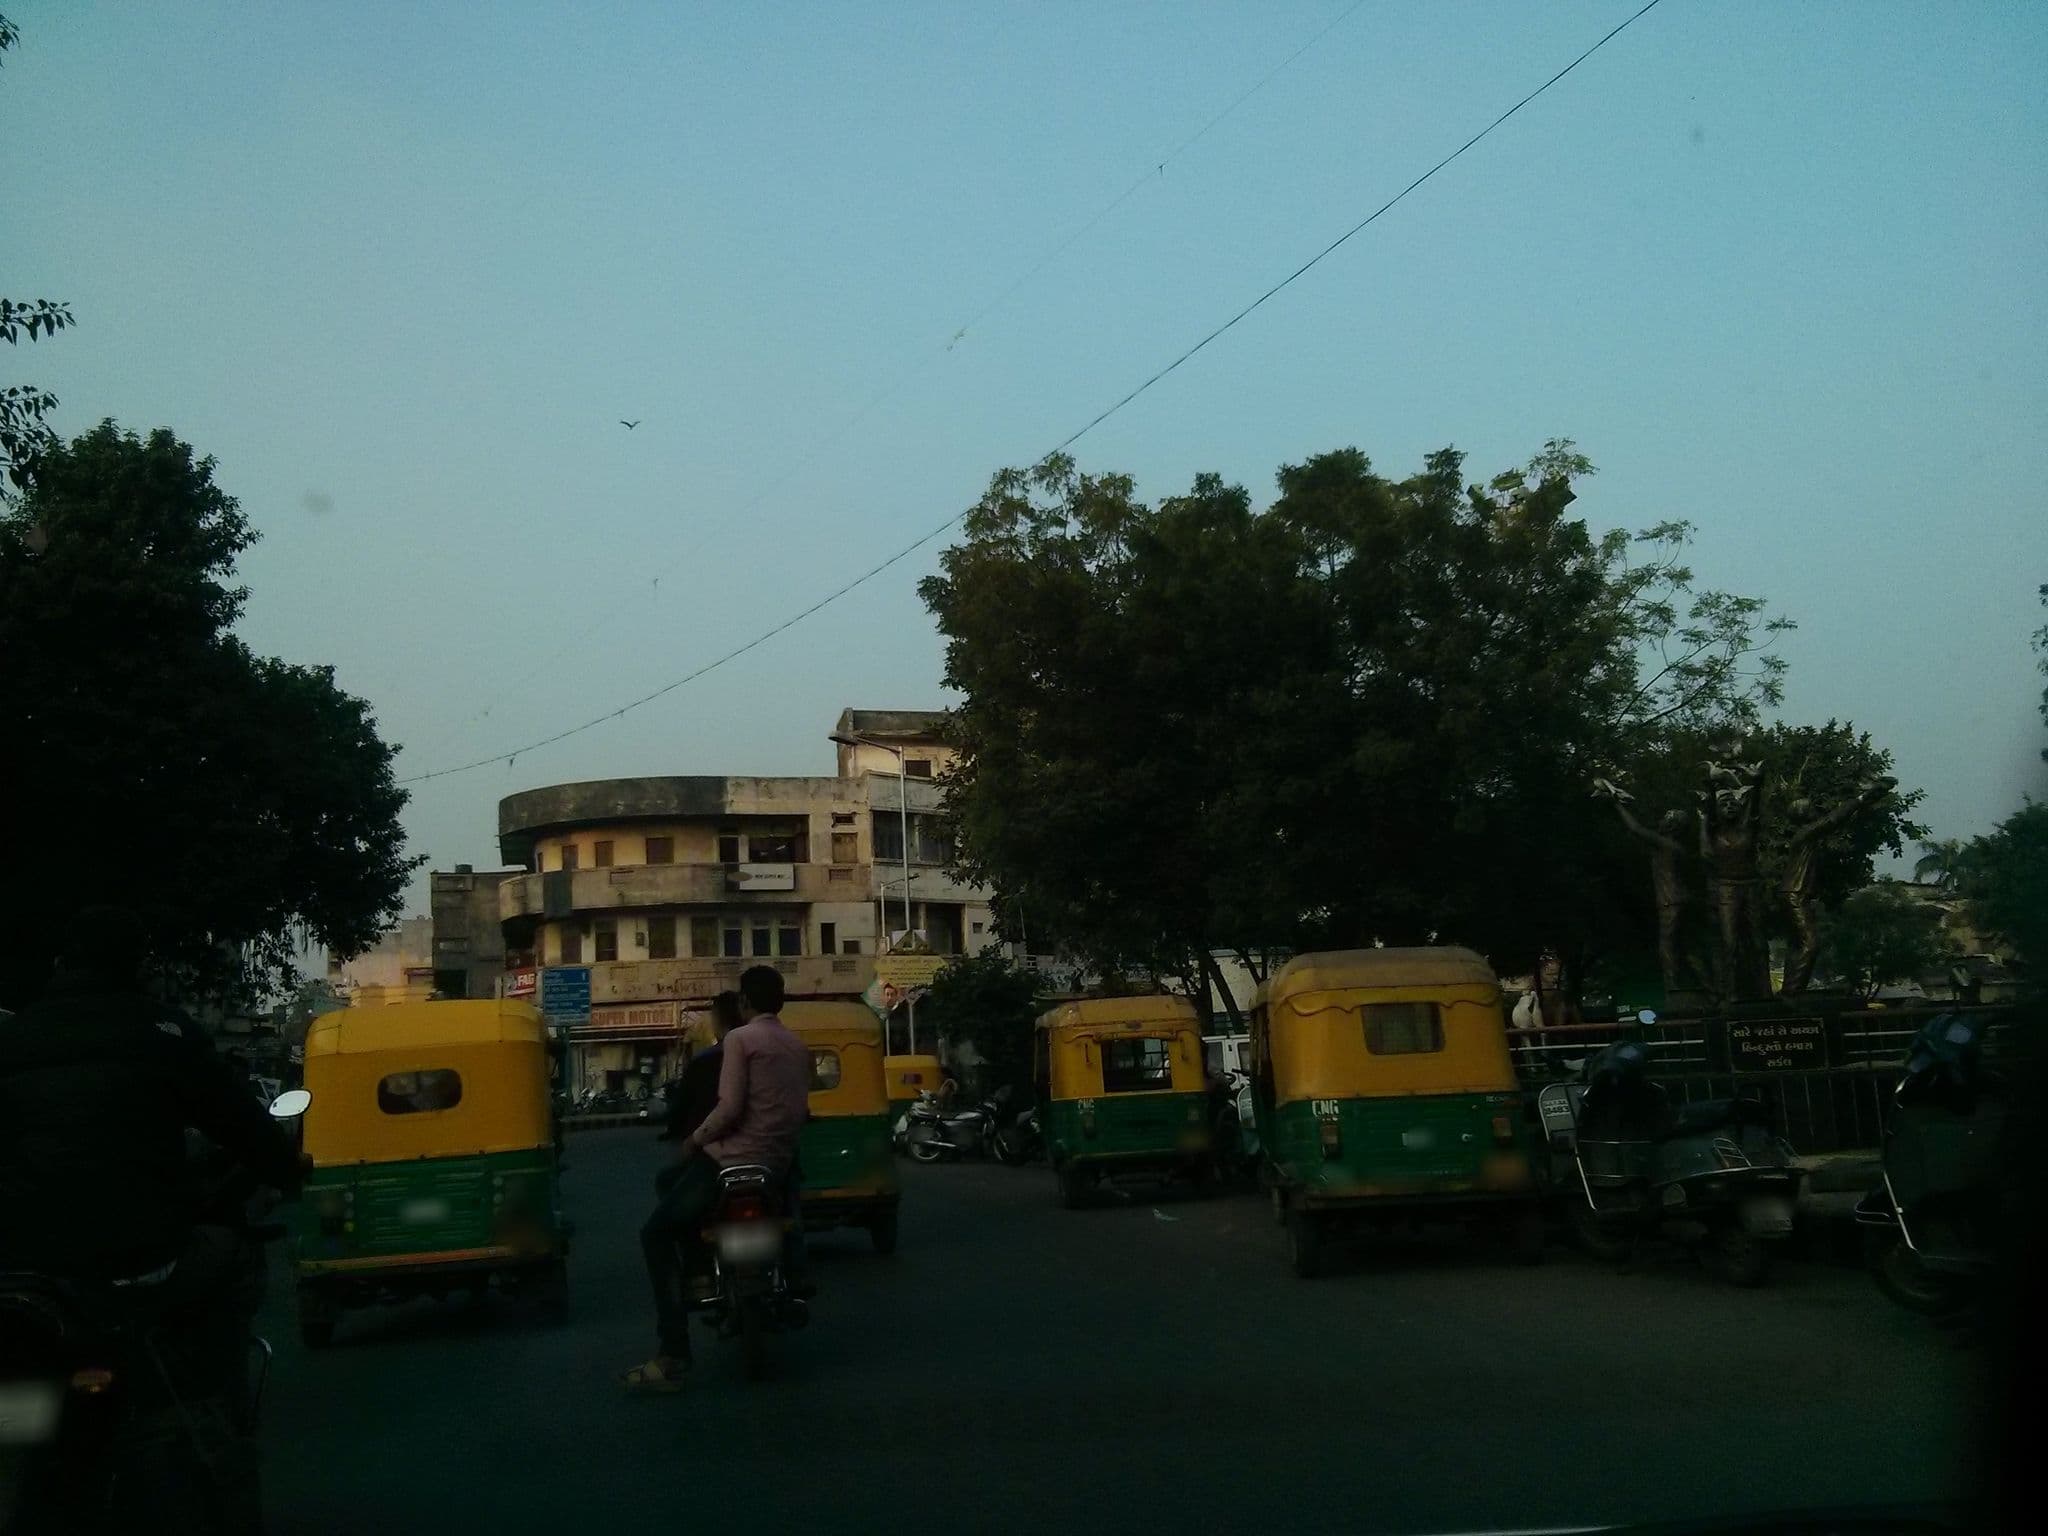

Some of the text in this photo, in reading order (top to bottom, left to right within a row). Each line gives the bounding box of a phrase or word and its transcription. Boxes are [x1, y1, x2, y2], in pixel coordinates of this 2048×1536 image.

[517, 973, 536, 987] FAG
[592, 1010, 627, 1025] SUPER
[1311, 1100, 1340, 1117] CNG
